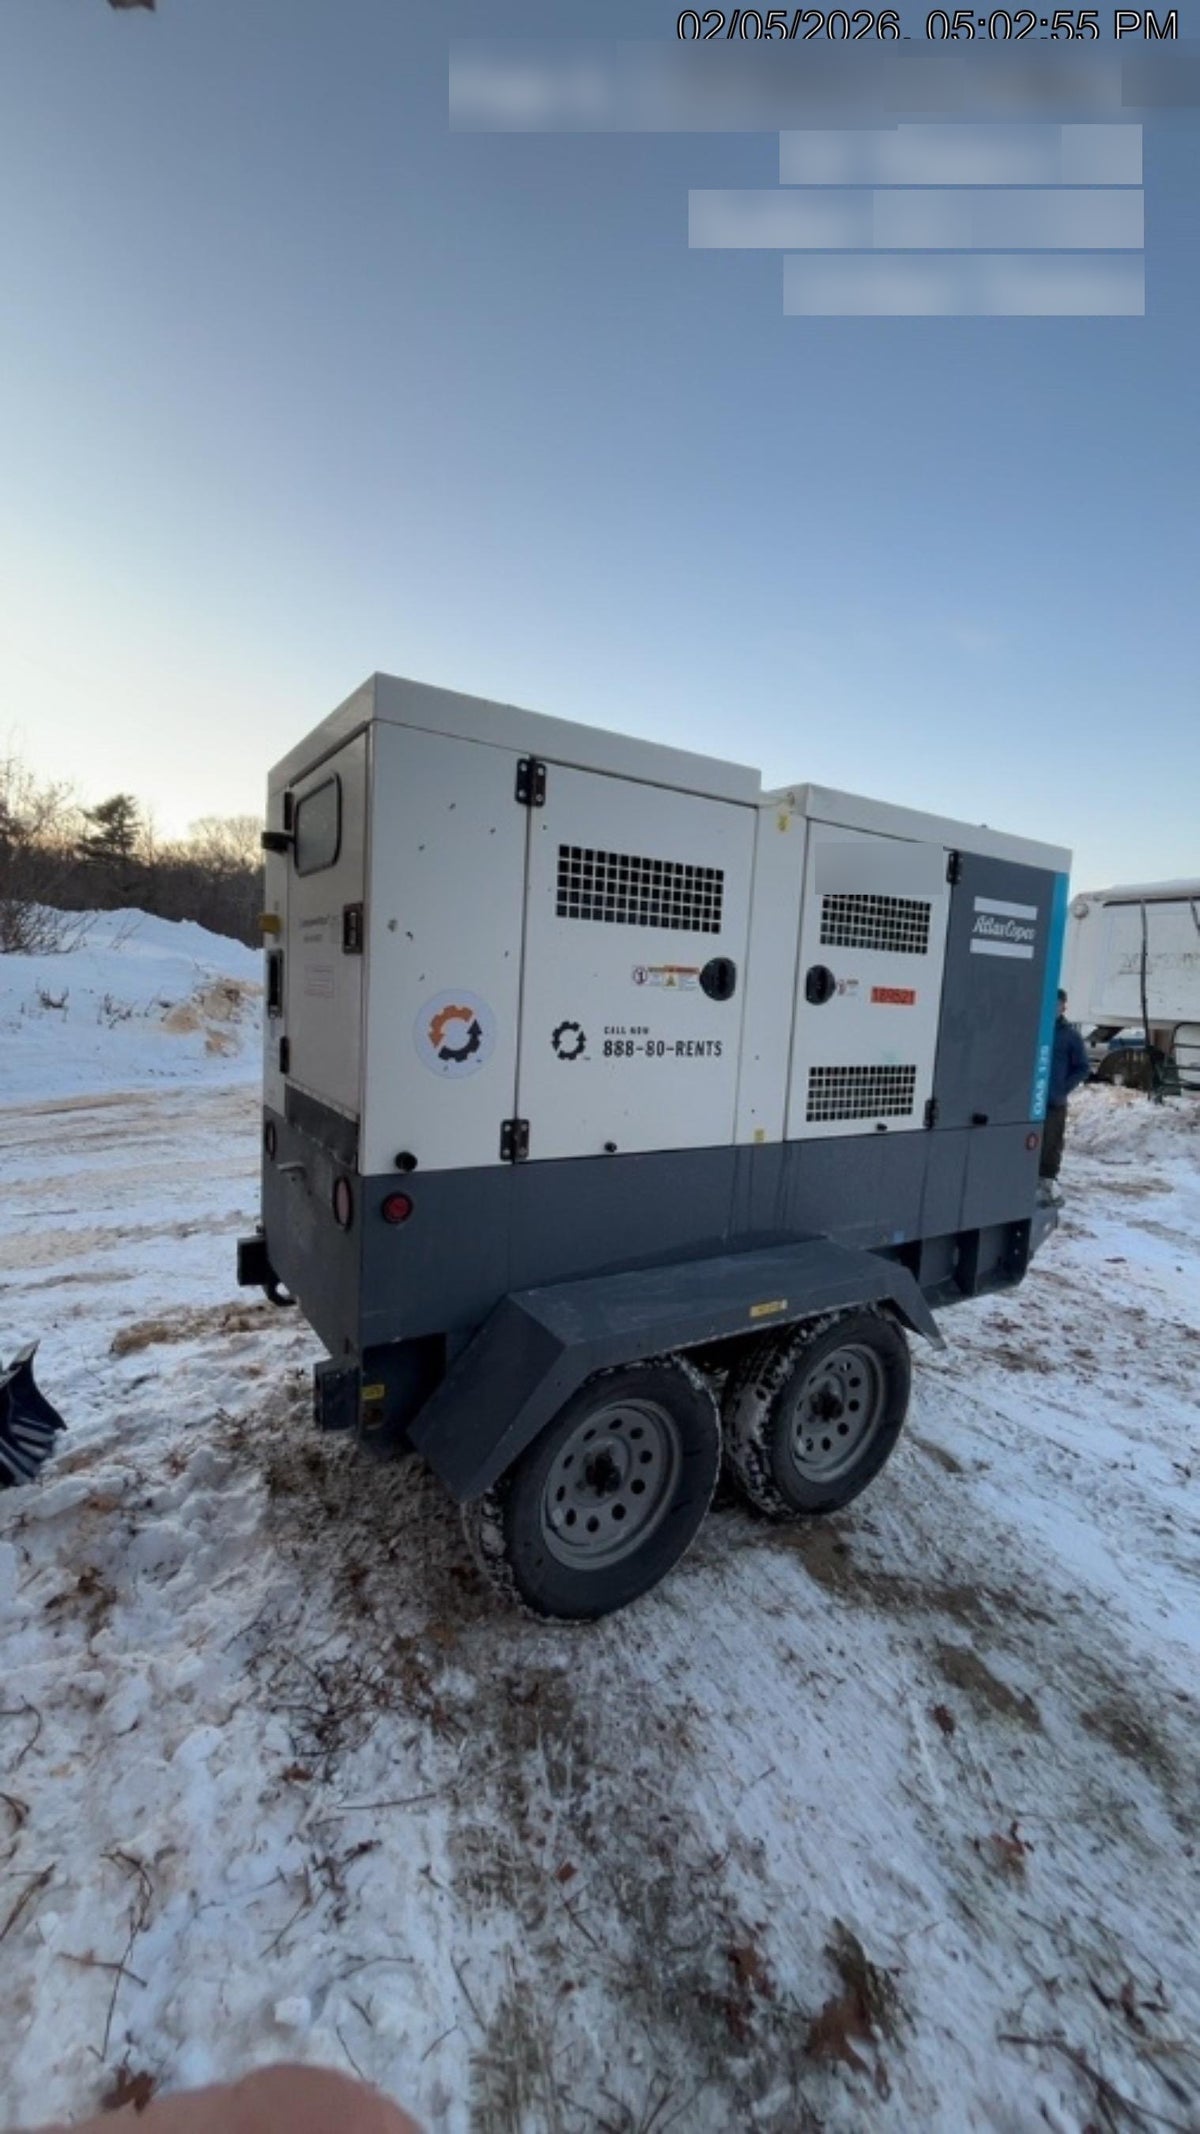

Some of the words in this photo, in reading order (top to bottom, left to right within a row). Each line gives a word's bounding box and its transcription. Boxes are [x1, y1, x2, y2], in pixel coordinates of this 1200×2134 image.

[603, 1026, 627, 1035] CALL
[630, 1026, 649, 1035] NOW
[603, 1040, 723, 1057] 888-80-RENTS
